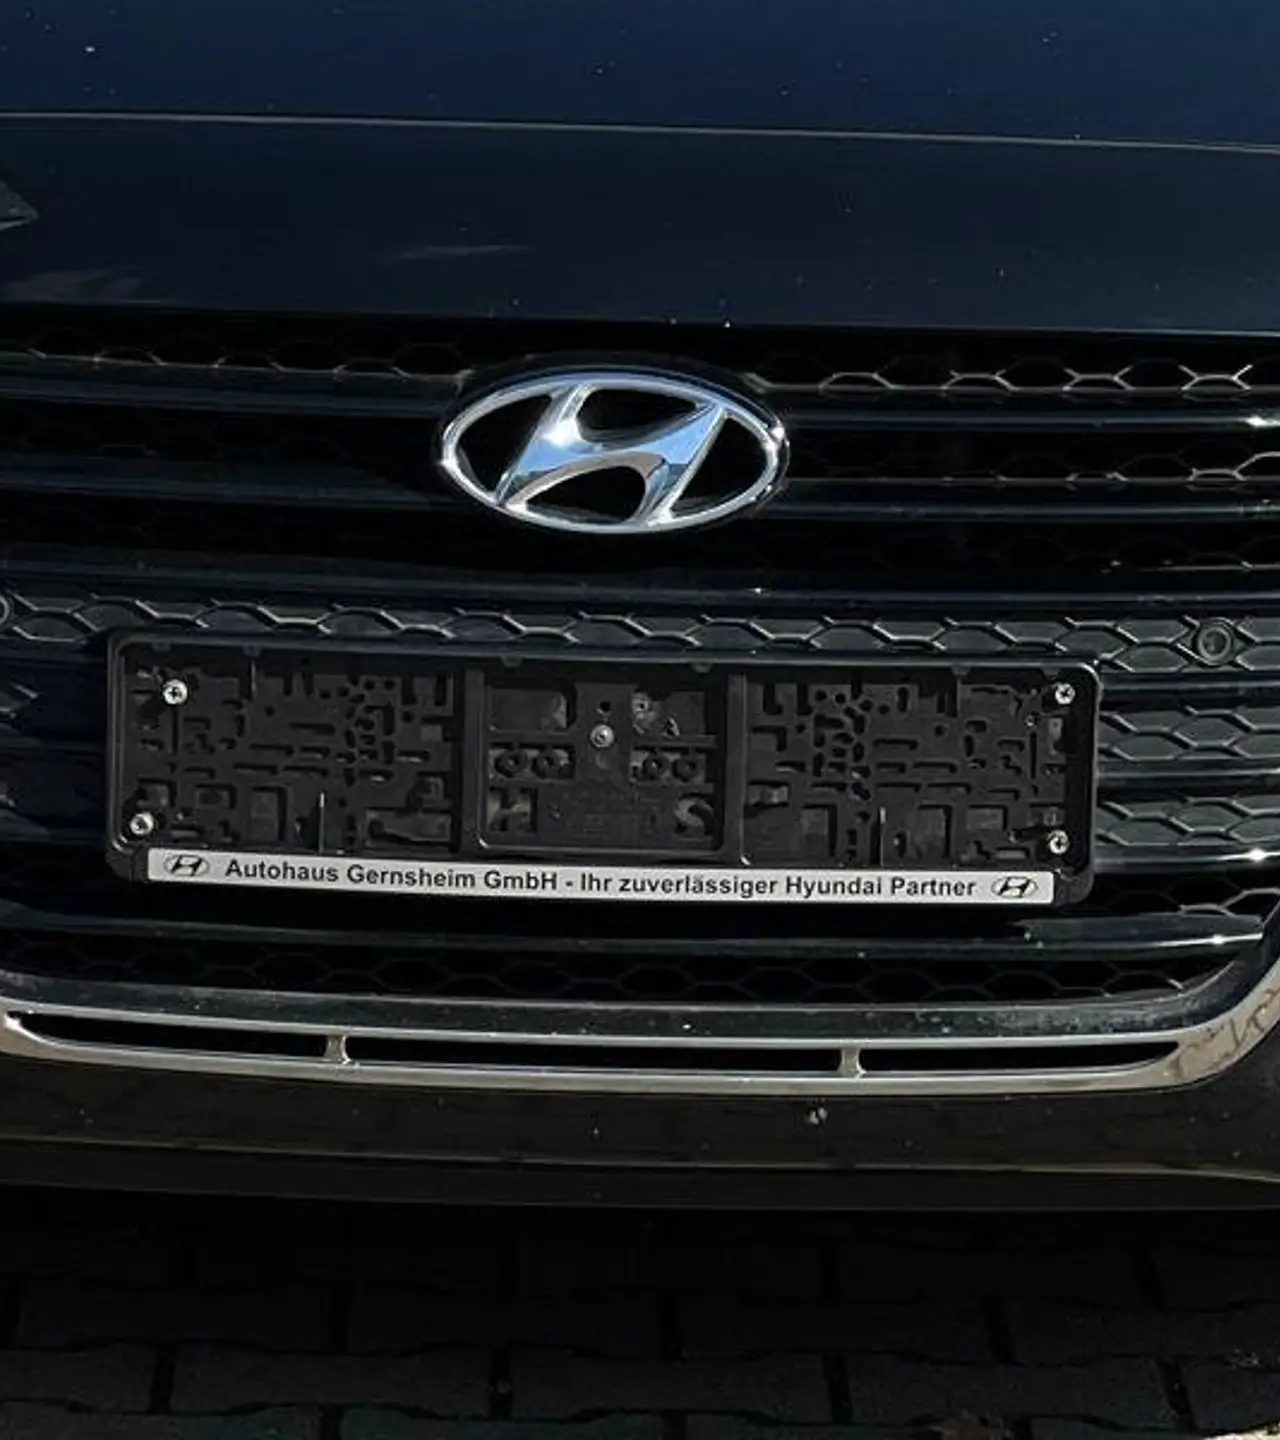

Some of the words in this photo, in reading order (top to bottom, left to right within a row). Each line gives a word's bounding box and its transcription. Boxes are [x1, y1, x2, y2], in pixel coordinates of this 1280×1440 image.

[225, 858, 339, 884] Autohaus
[346, 867, 476, 891] Gernsheim
[483, 872, 558, 894] GmbH
[580, 875, 613, 893] Ihr
[619, 875, 777, 899] zuverlässiger
[785, 878, 883, 900] Hyundai
[891, 879, 978, 898] Partner
